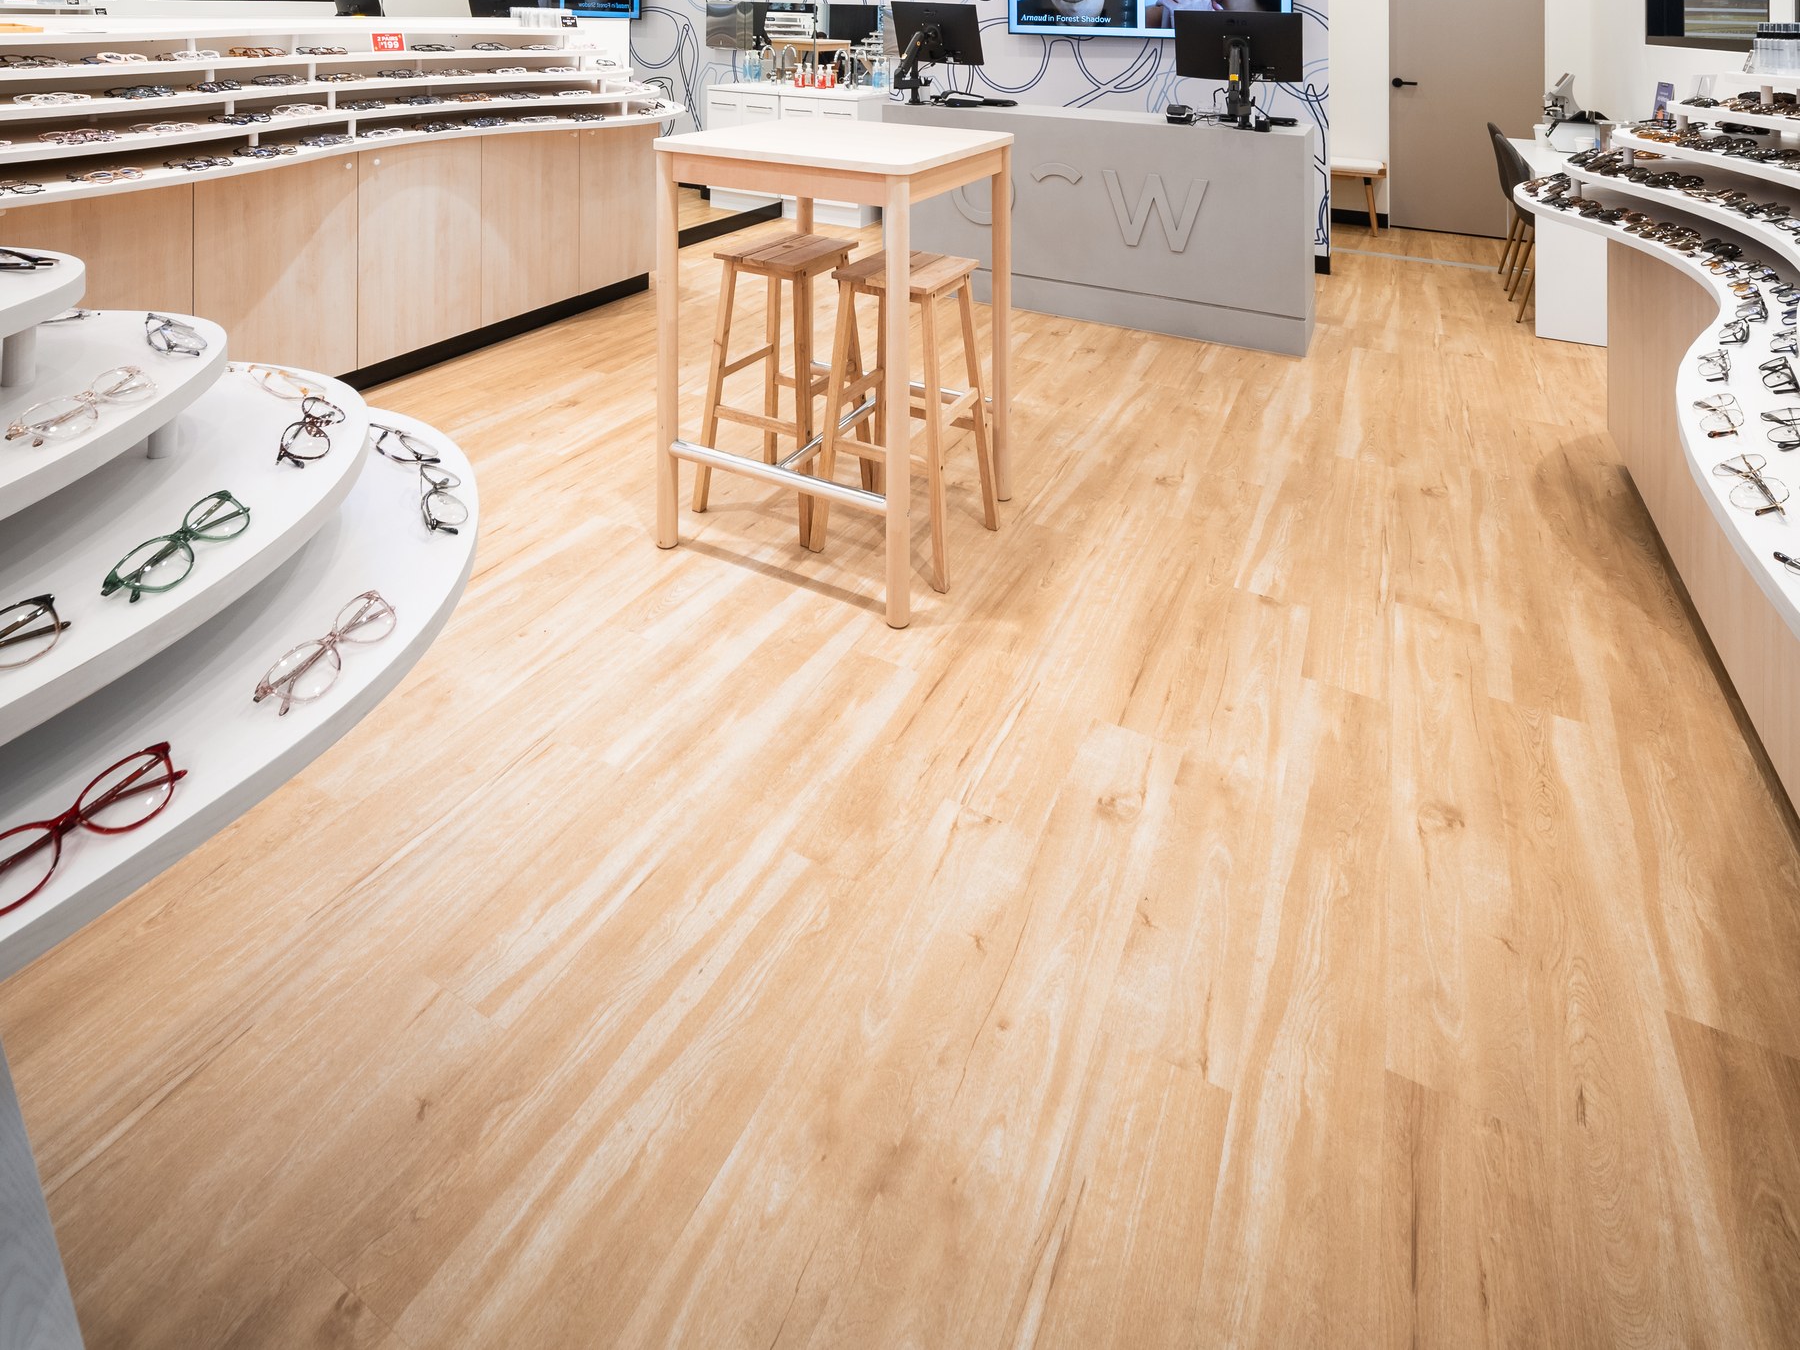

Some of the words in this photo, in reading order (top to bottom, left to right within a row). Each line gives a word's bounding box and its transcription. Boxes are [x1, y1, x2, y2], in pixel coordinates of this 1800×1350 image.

[1020, 13, 1047, 22] Arnaud
[1047, 14, 1055, 22] in
[1056, 14, 1080, 23] Forest
[1081, 15, 1112, 23] Shadow
